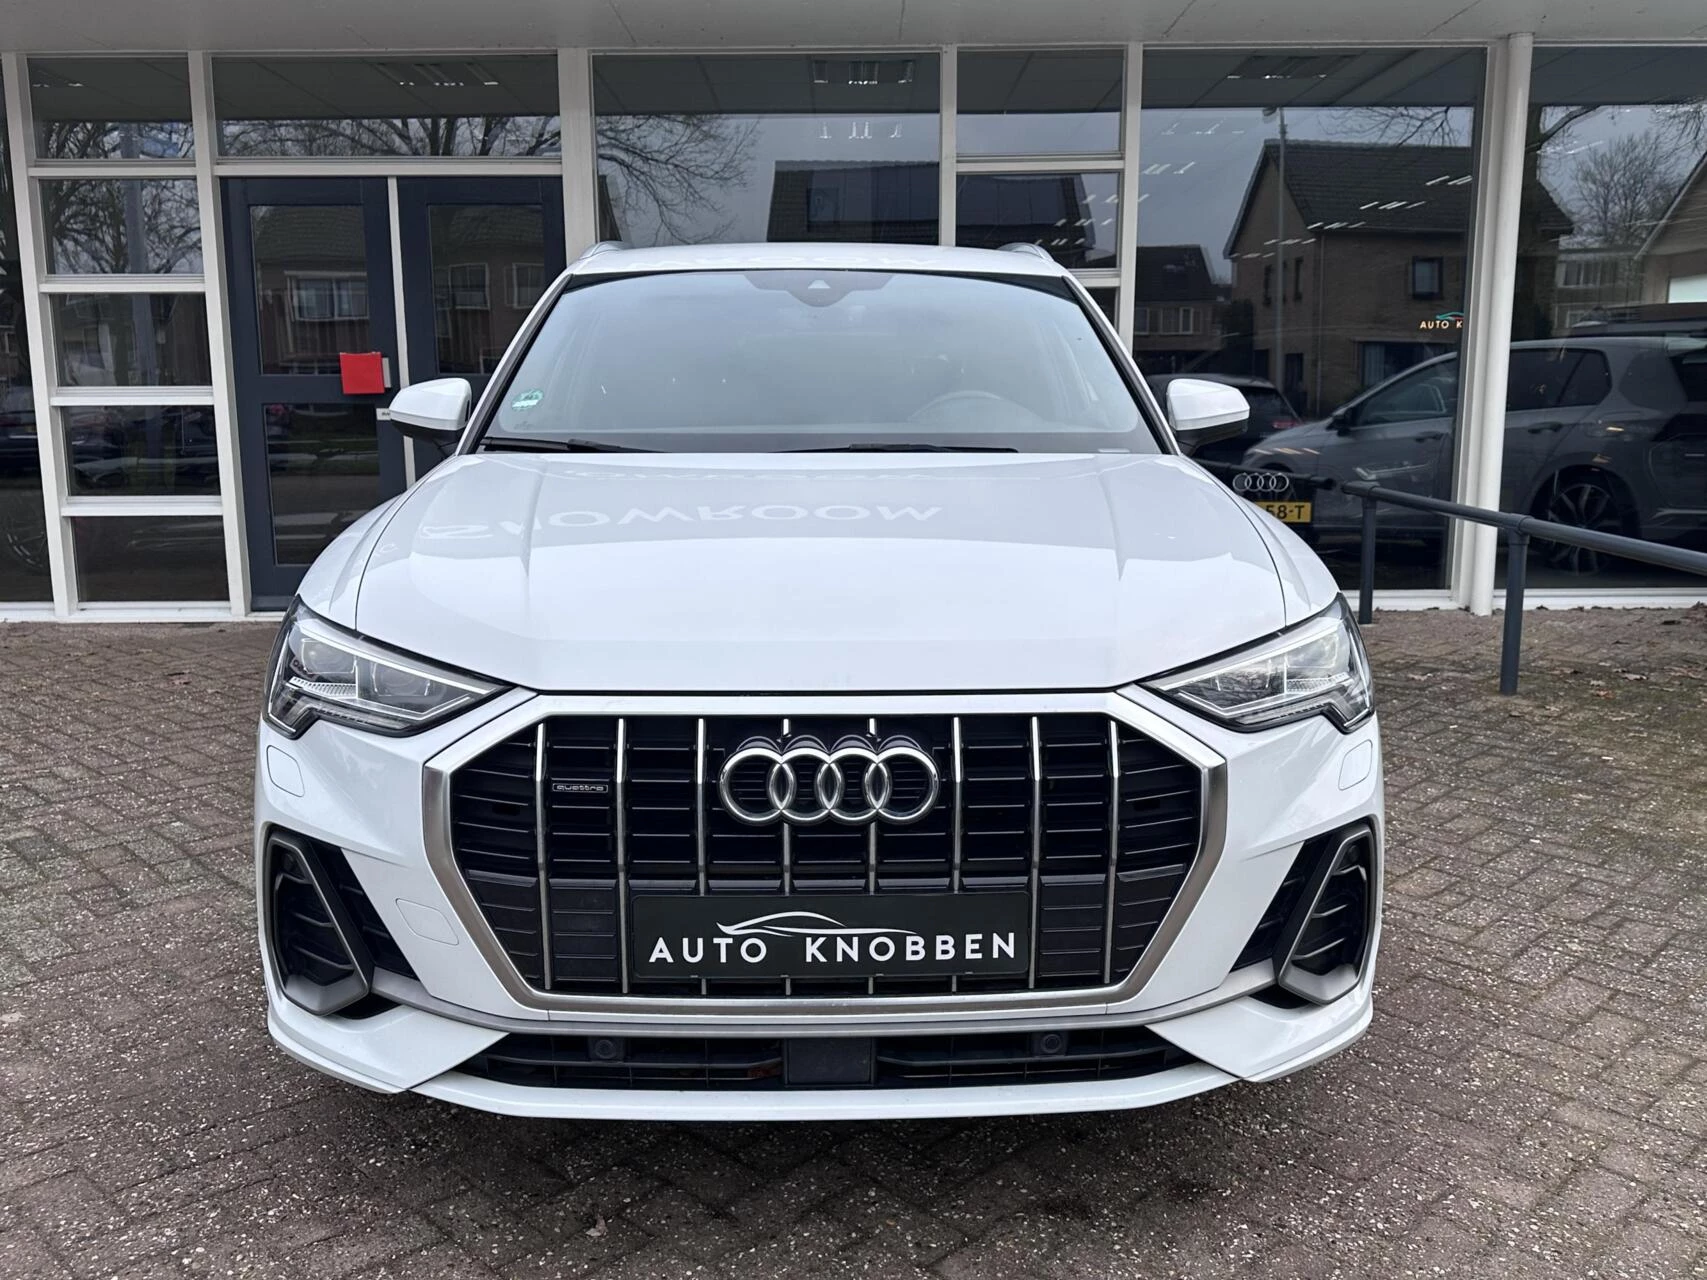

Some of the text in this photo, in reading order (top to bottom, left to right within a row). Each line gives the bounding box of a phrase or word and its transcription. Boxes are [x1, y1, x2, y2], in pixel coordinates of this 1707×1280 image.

[1419, 320, 1449, 329] AUTO
[648, 931, 1015, 964] AUTO KNOBBEN
